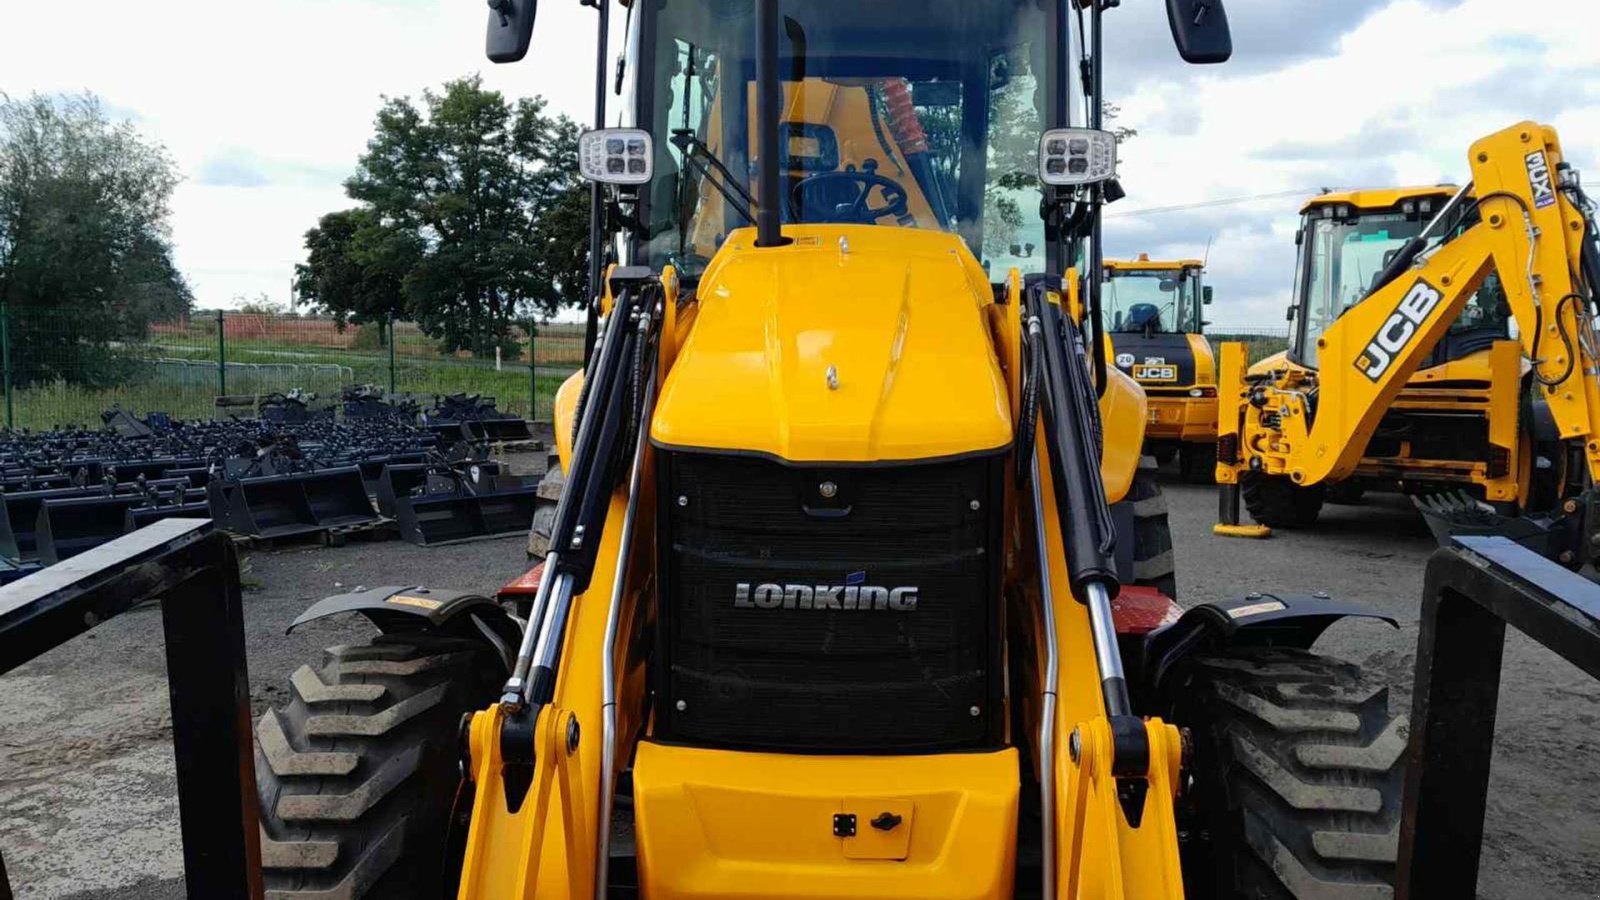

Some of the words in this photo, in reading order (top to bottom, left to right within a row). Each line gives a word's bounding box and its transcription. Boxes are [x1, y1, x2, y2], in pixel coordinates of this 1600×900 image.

[1365, 282, 1440, 379] JCB
[1136, 367, 1174, 378] JCB
[734, 571, 919, 611] LONKING
